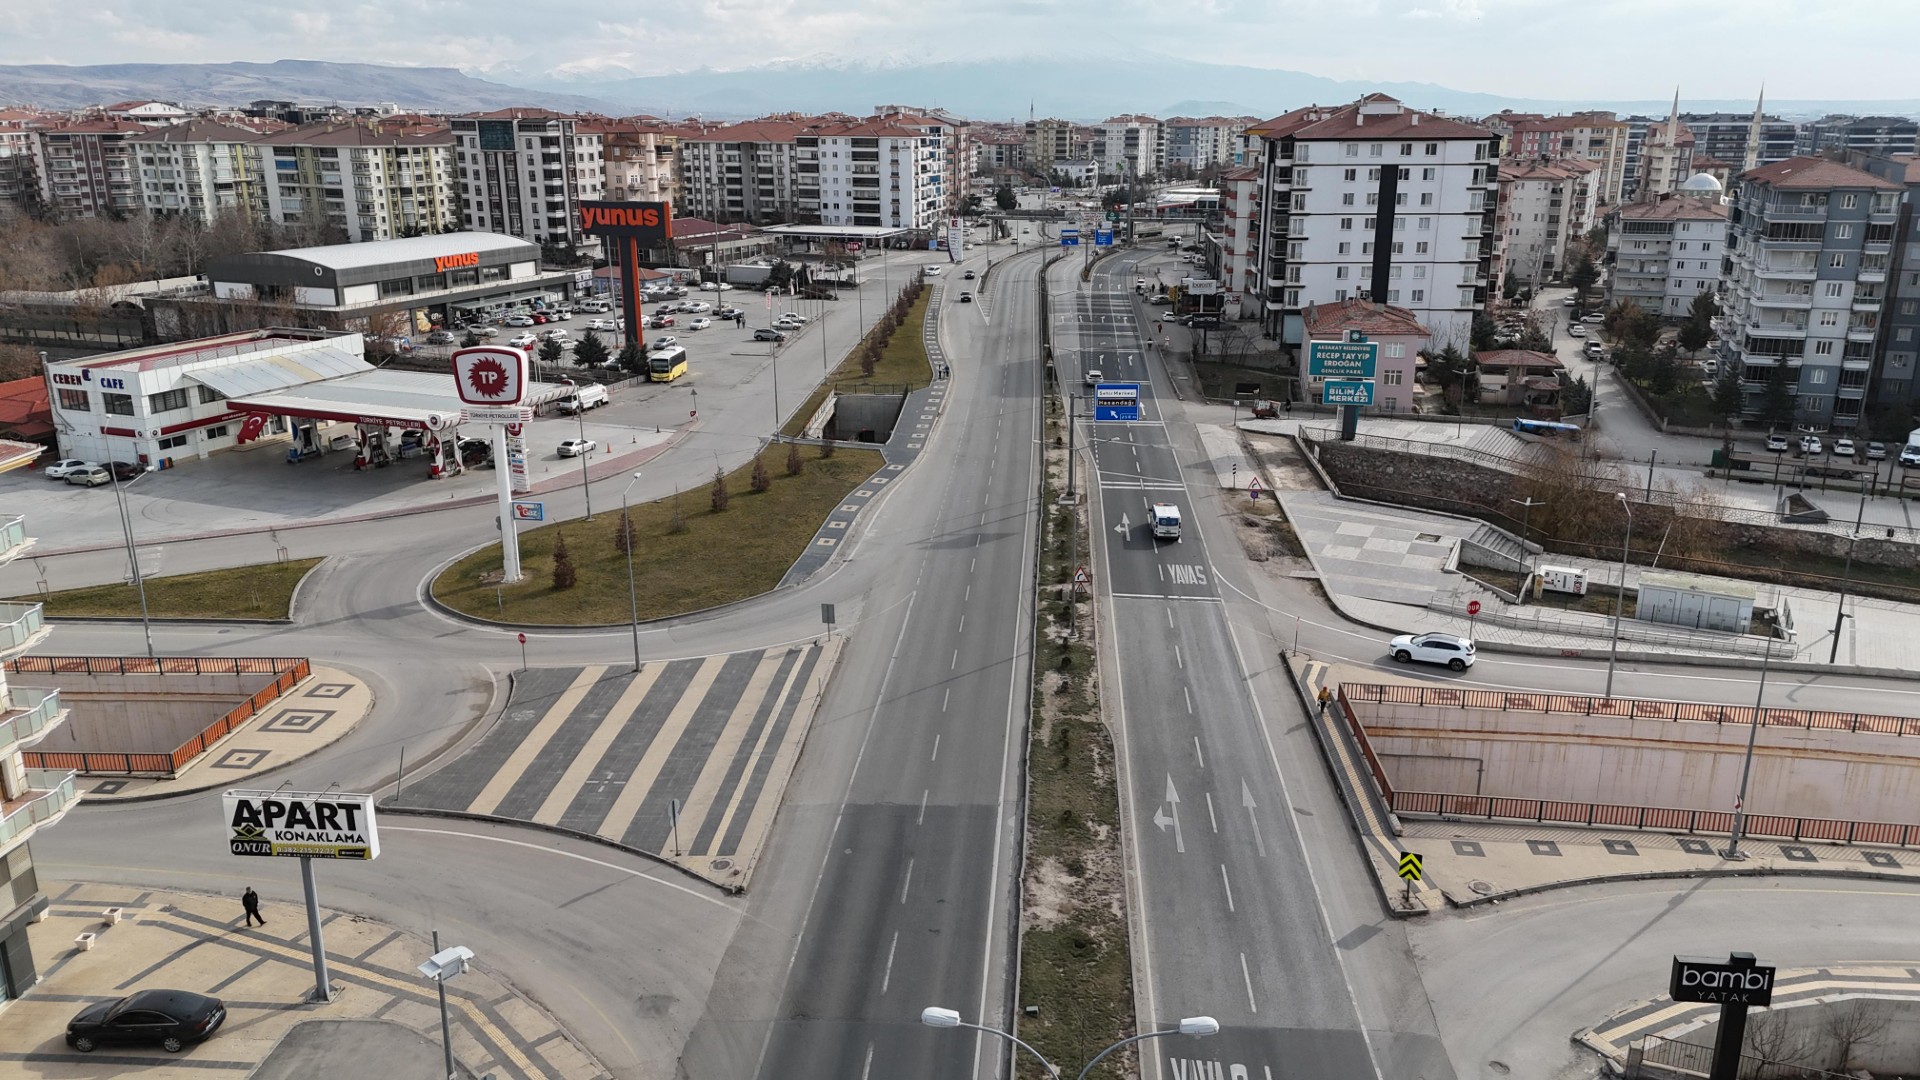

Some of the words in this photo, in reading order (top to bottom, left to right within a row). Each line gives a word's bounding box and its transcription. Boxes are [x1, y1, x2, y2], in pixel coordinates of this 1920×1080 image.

[581, 207, 659, 229] yunus
[434, 251, 479, 273] yunus
[1324, 360, 1362, 368] ERDOĞAN
[53, 373, 82, 386] CEREN
[100, 378, 124, 389] CAFE
[479, 371, 498, 384] TP
[359, 416, 383, 425] TÜRKİYE
[386, 419, 421, 428] PETROLLERİ
[231, 799, 362, 832] APART
[274, 830, 366, 844] KONAKLAMA
[232, 842, 271, 853] ONUR
[1682, 965, 1770, 990] bambi
[1697, 990, 1750, 1003] YATAK
